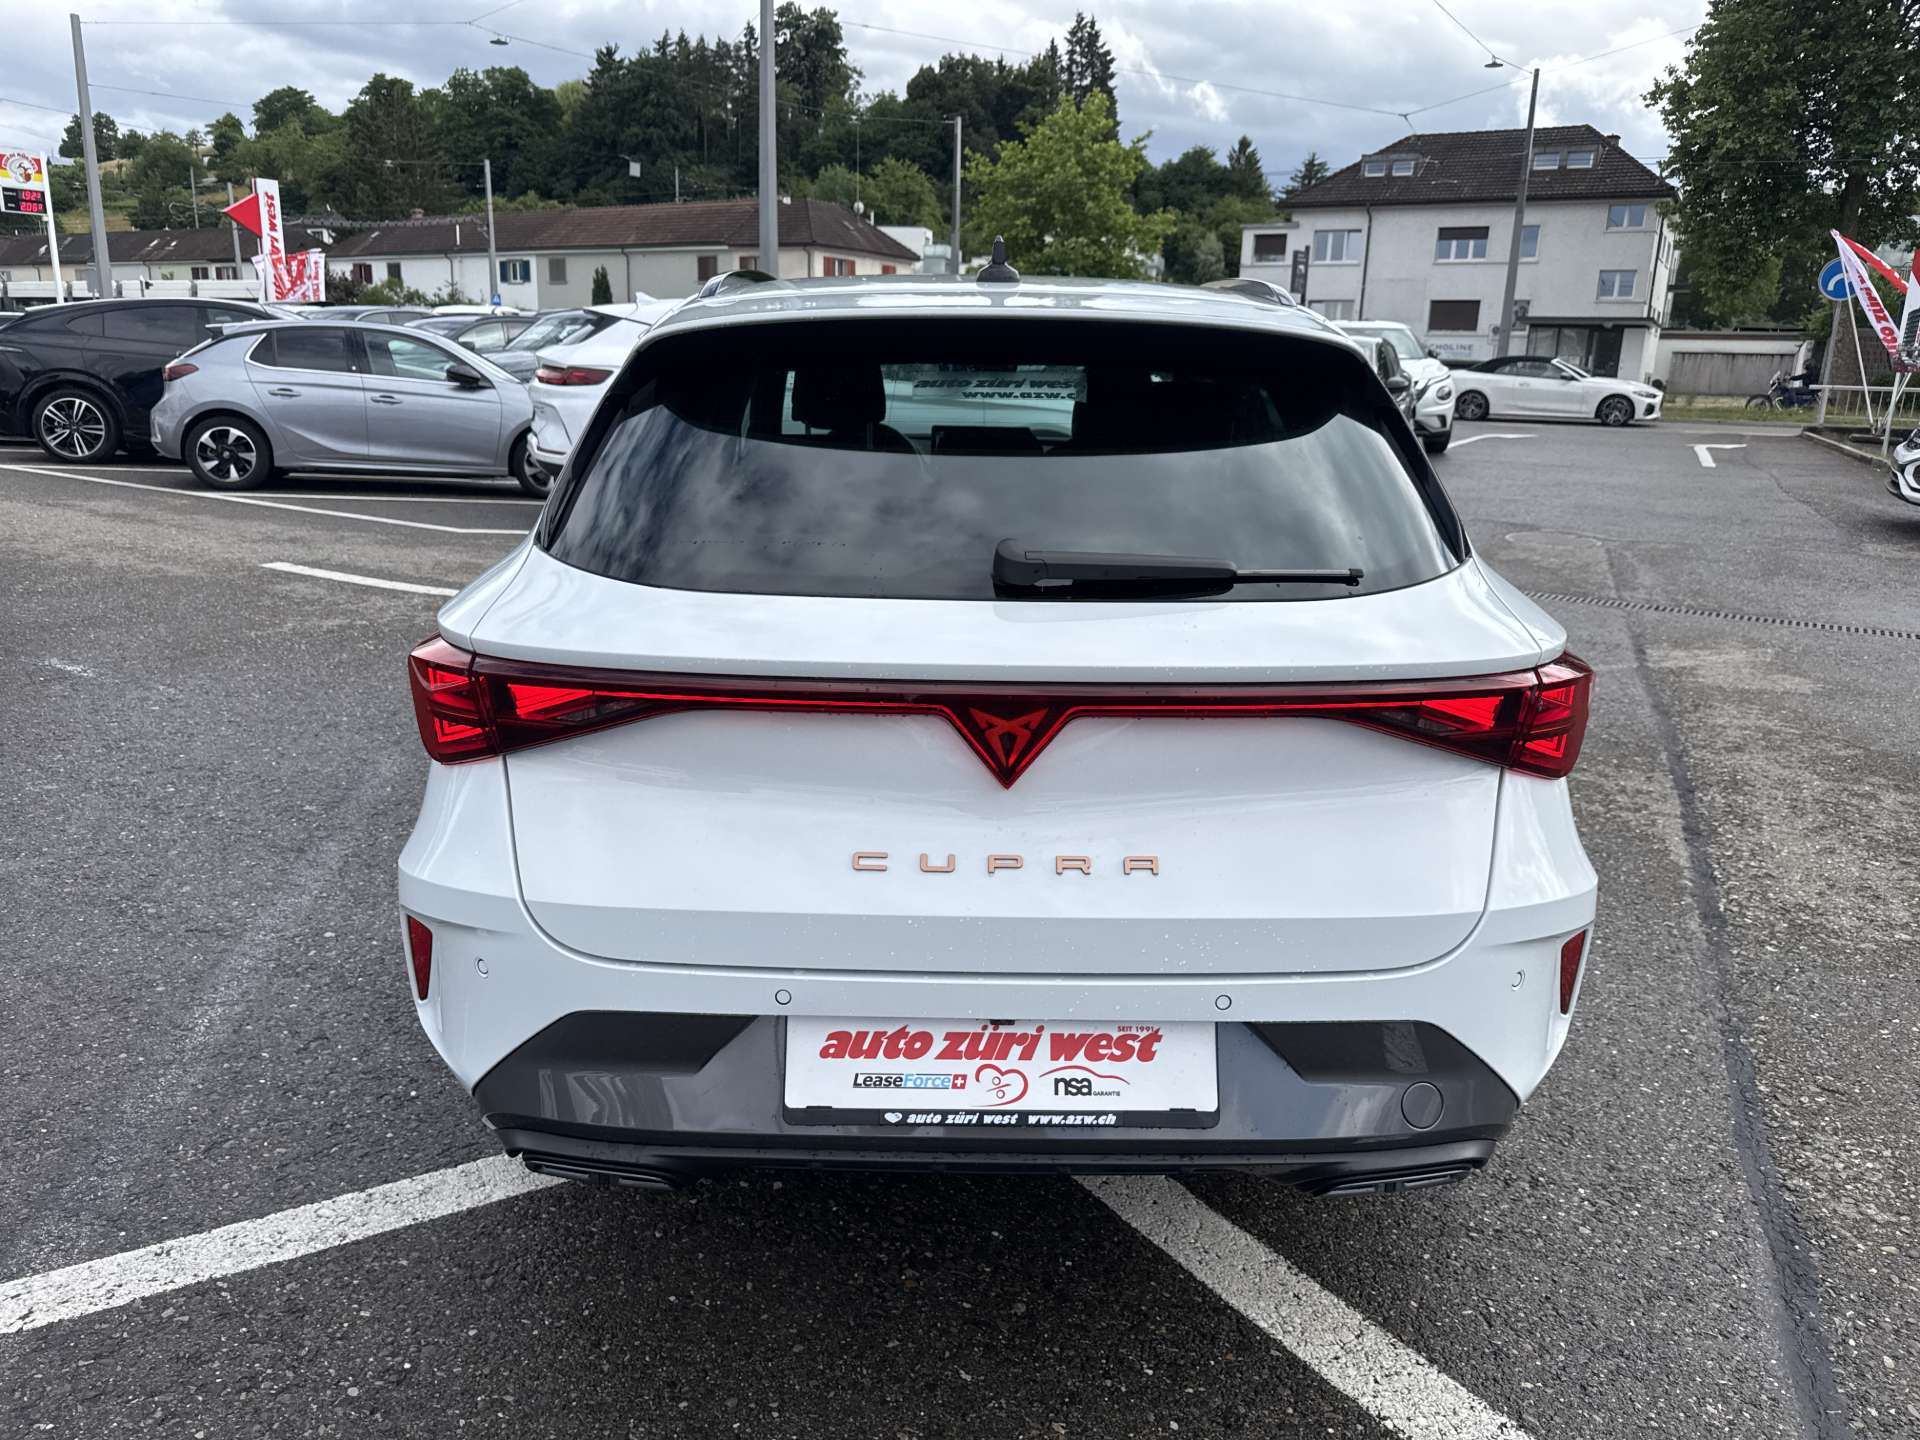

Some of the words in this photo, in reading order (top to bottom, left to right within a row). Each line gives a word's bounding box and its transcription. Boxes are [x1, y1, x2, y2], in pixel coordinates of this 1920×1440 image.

[1030, 379, 1075, 388] wes
[961, 391, 1076, 399] www.azw.c
[851, 851, 1159, 875] CUPRA
[819, 1024, 934, 1060] auto
[934, 1024, 1045, 1061] züri
[1050, 1027, 1163, 1062] west
[853, 1073, 951, 1088] LeaseForce
[1054, 1077, 1092, 1096] nsa
[906, 1112, 942, 1124] auto
[945, 1112, 979, 1124] züri
[983, 1113, 1019, 1125] west
[1028, 1113, 1117, 1125] www.azw.ch
